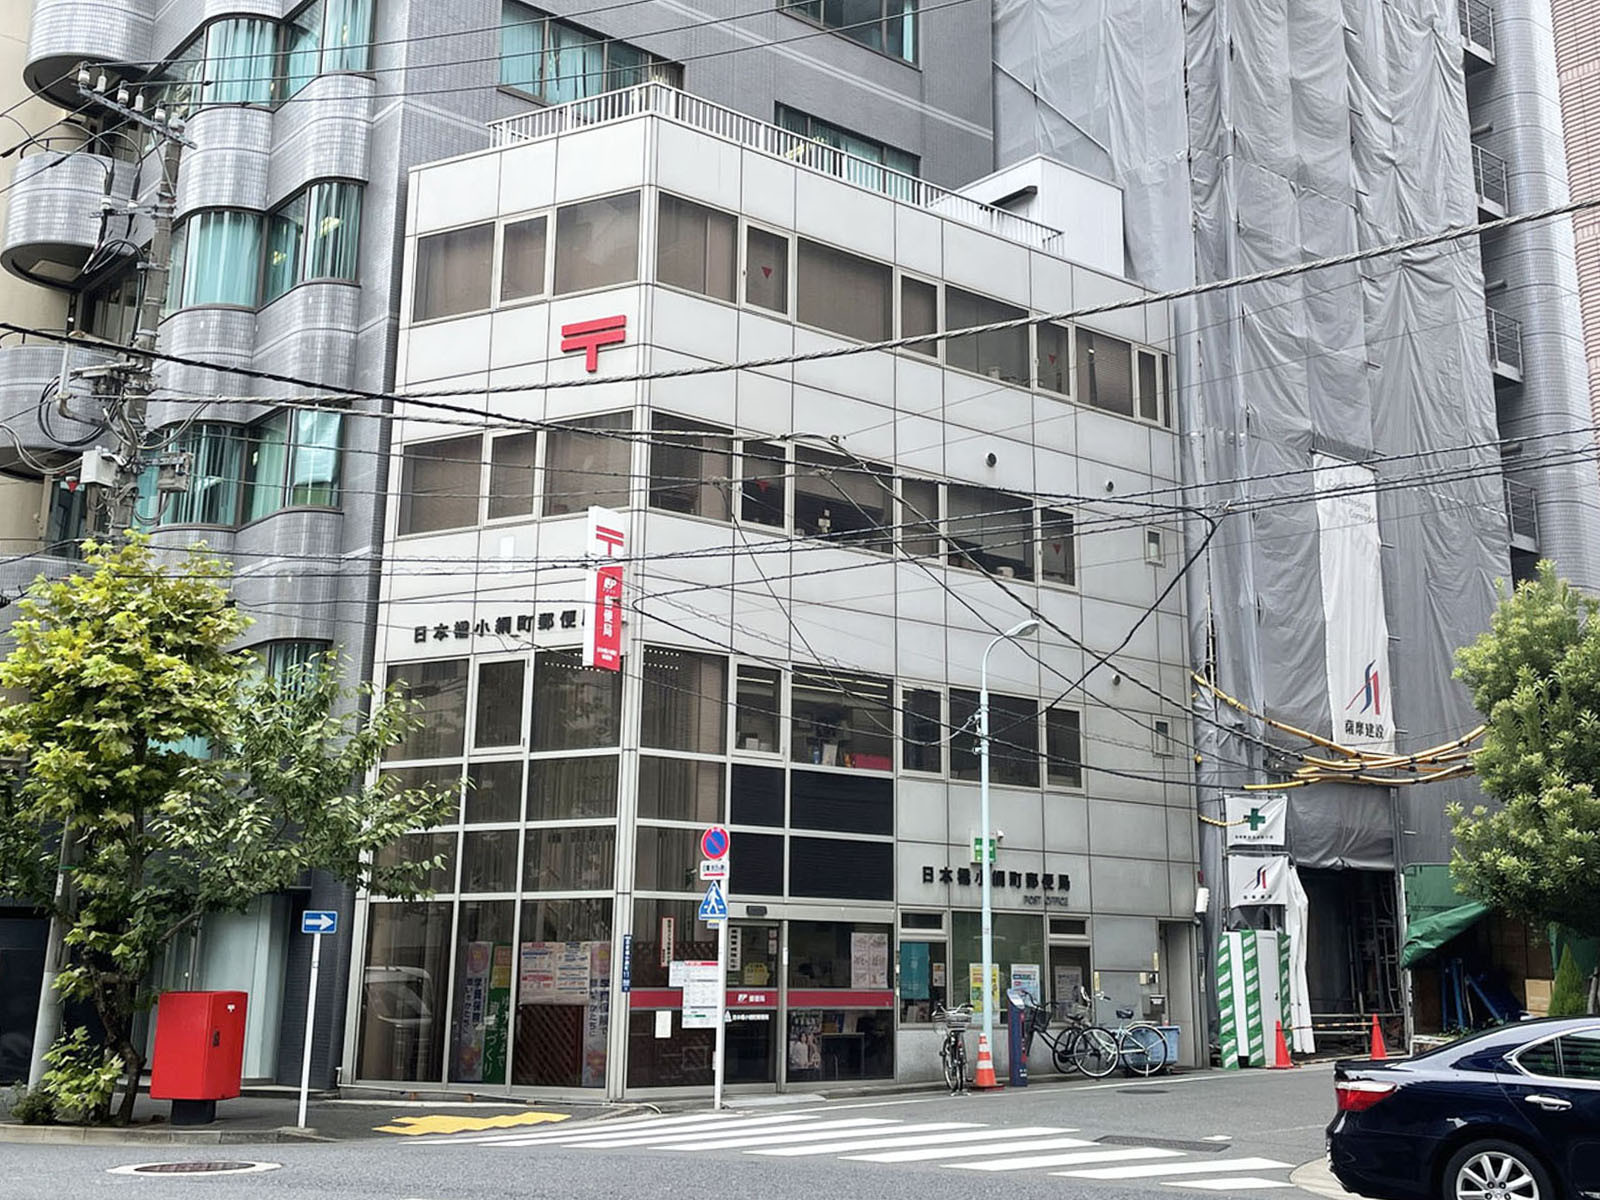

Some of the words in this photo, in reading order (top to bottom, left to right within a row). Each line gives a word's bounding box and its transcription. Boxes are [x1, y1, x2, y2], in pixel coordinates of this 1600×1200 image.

[414, 609, 585, 643] 日本橋小網町郵便
